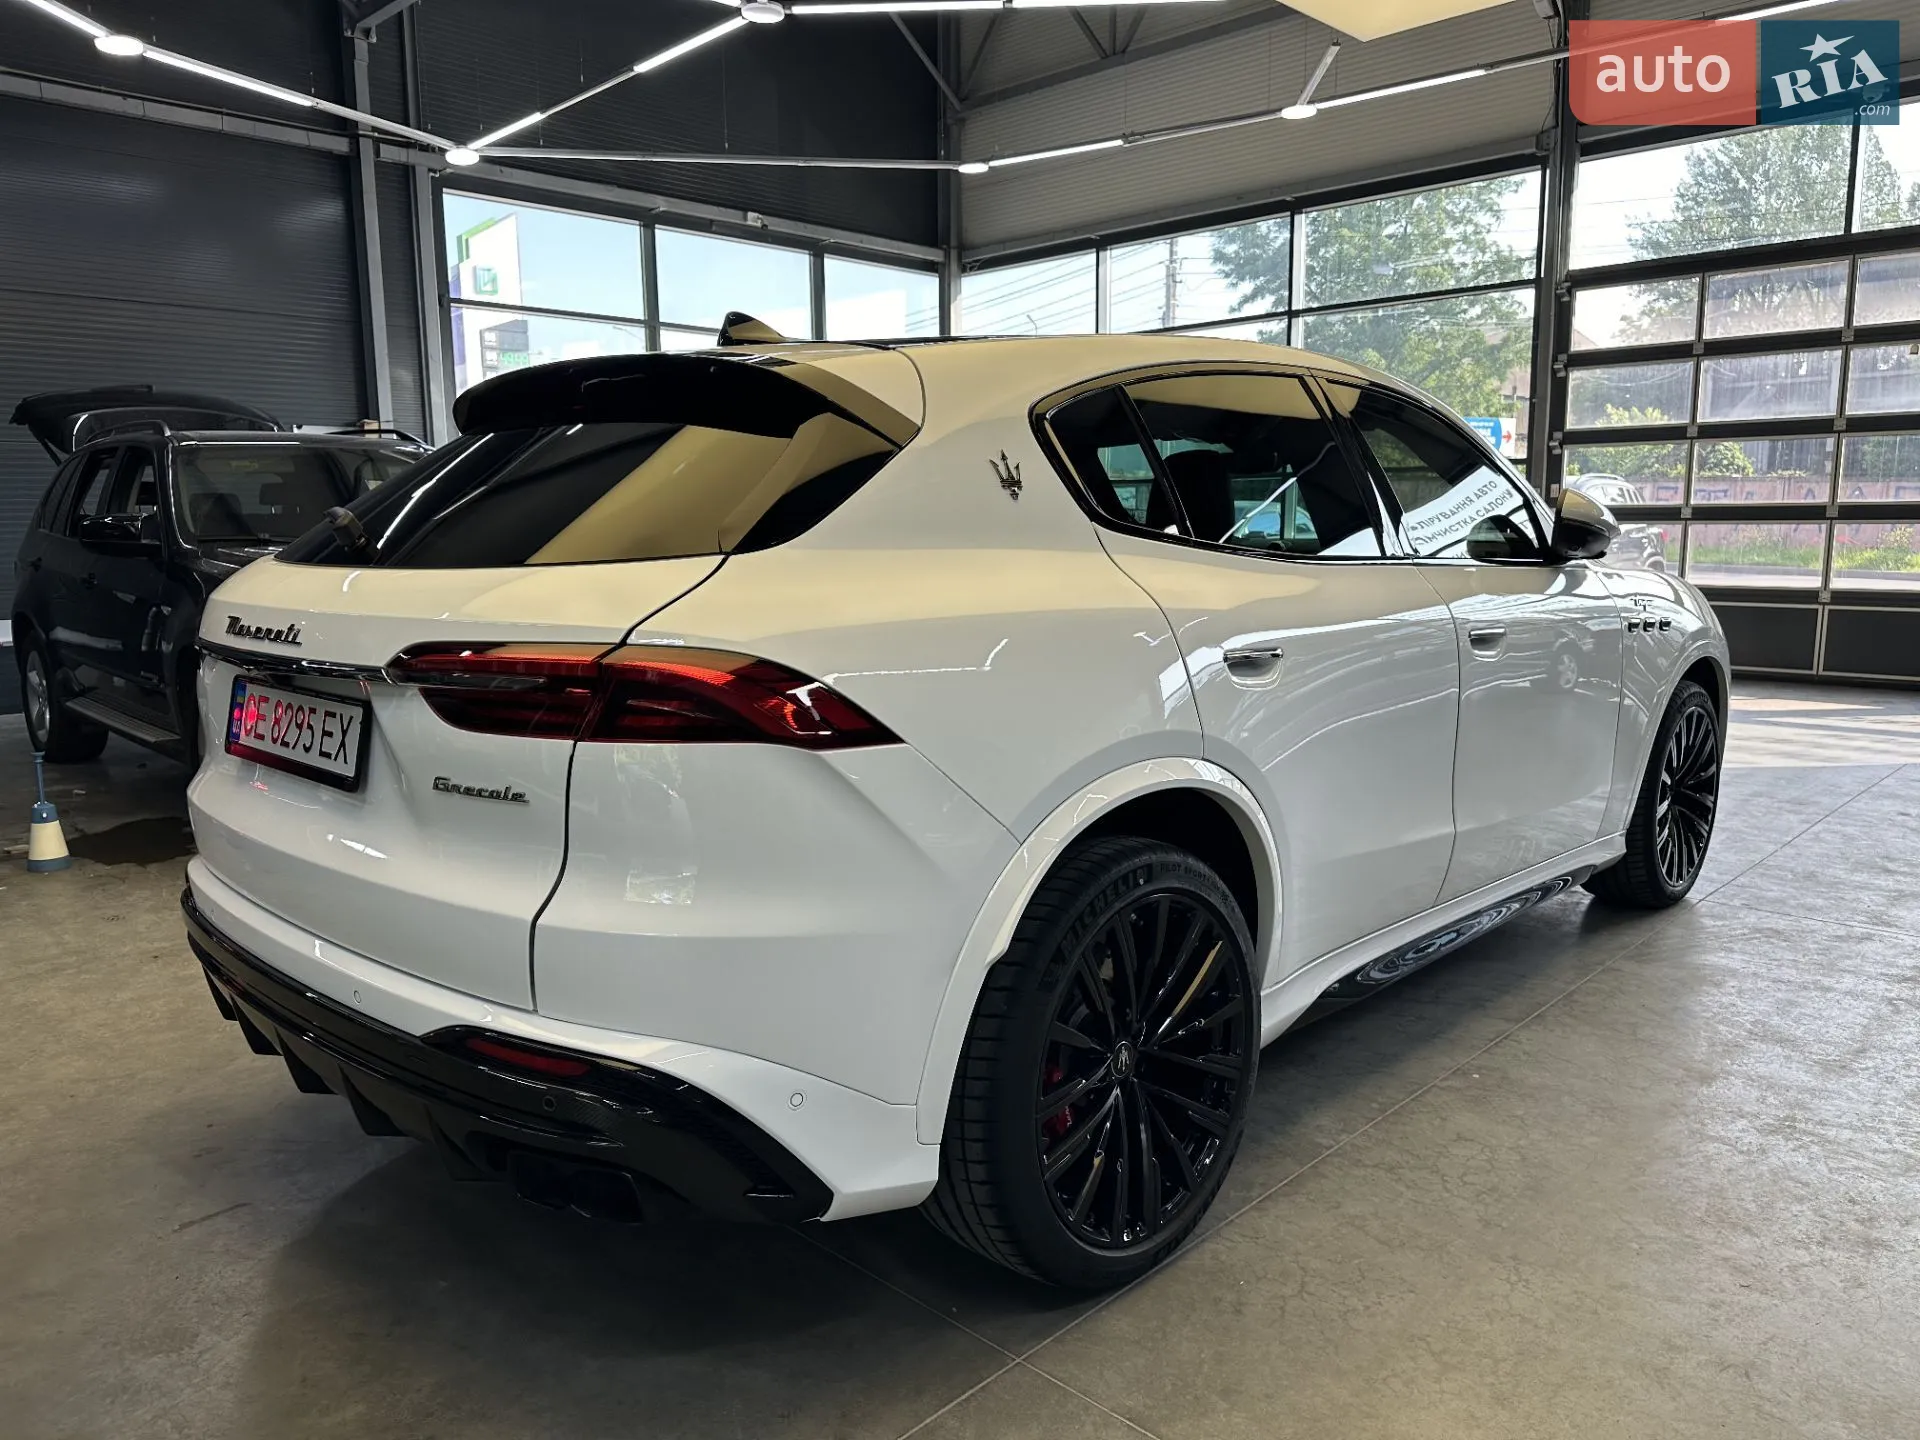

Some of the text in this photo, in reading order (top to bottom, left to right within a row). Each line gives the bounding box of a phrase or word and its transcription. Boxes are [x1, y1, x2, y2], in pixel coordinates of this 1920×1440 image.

[1473, 480, 1498, 500] АВТО
[1475, 488, 1514, 518] САЛОНУ
[225, 615, 302, 647] Maserati
[243, 693, 354, 765] CE 8295 EX
[432, 775, 531, 804] Grecale
